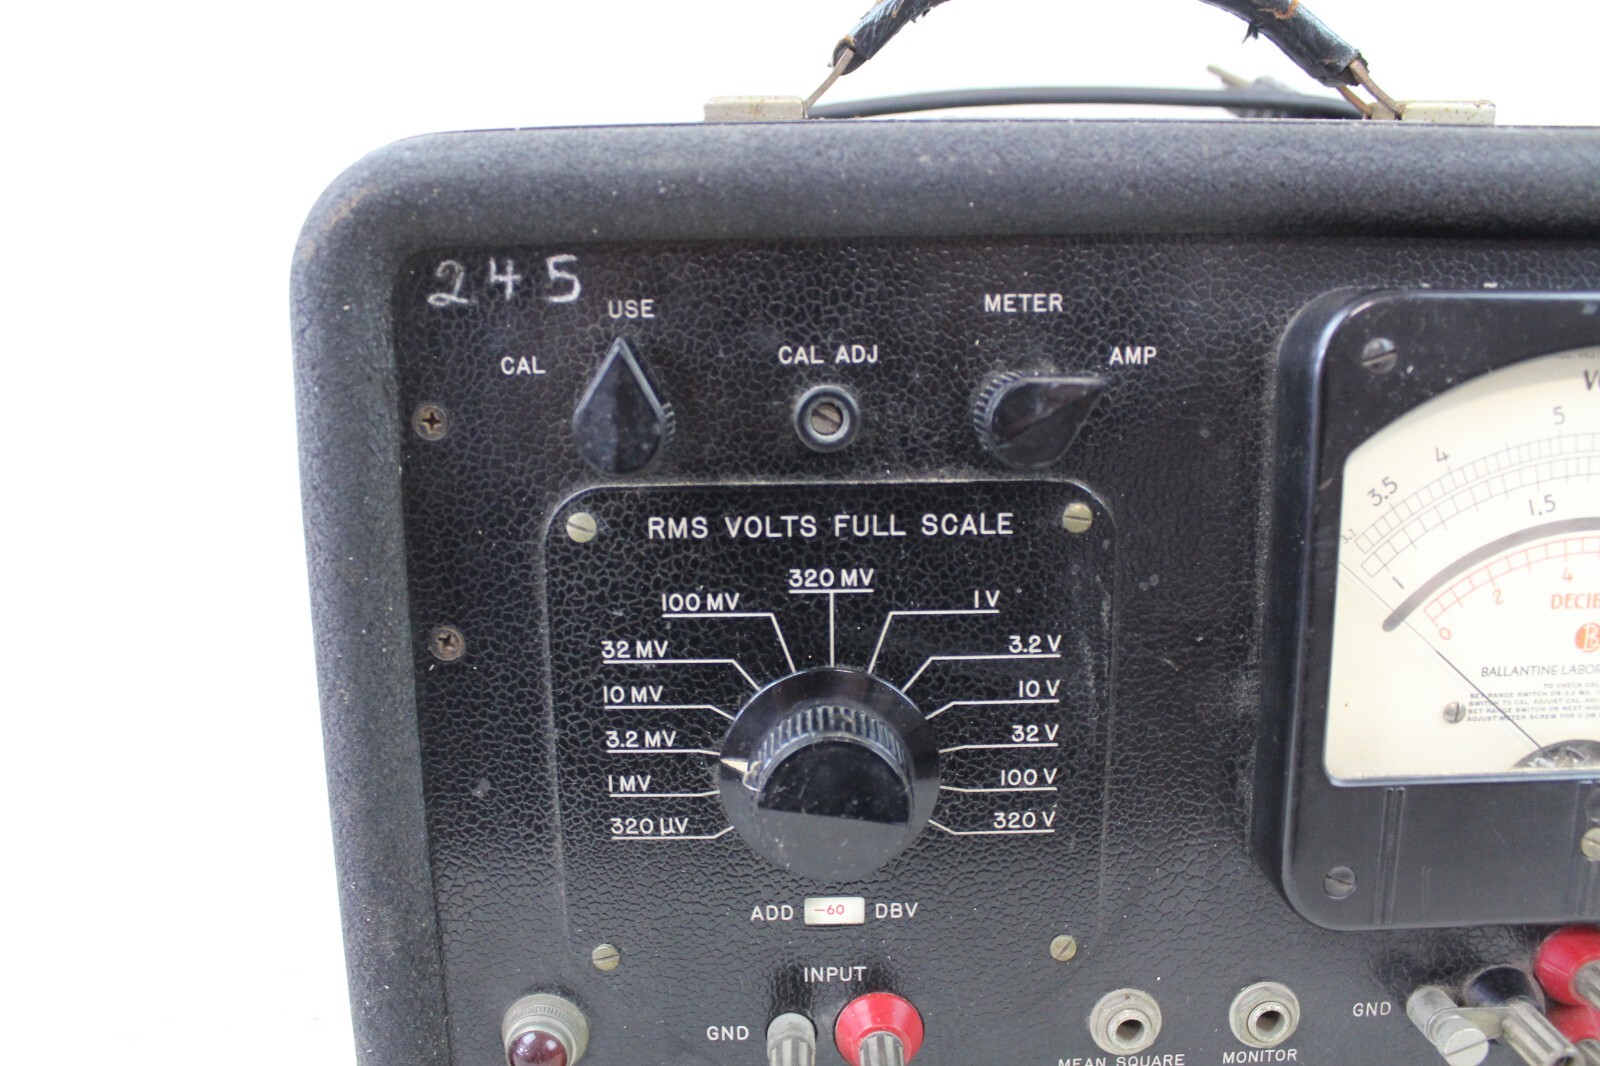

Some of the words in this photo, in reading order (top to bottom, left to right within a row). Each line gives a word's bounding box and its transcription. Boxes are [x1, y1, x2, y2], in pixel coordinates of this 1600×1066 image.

[607, 299, 655, 320] USE
[983, 293, 1064, 313] METER
[776, 345, 825, 365] CAL
[835, 344, 879, 364] ADJ
[1108, 345, 1158, 366] AMP
[500, 356, 546, 376] CAL
[1582, 368, 1600, 392] V
[1553, 405, 1566, 426] 5
[1434, 446, 1450, 464] 4
[1367, 475, 1399, 508] 3.5
[1528, 494, 1557, 517] 1.5
[647, 516, 709, 540] RMS
[724, 515, 818, 539] VOLTS
[834, 513, 907, 537] FULL
[921, 512, 1014, 536] SCALE
[788, 568, 835, 588] 320
[840, 567, 875, 587] MV
[1562, 567, 1574, 583] 4
[661, 593, 701, 612] 100
[706, 592, 740, 612] MV
[973, 589, 980, 609] 1
[985, 589, 1001, 608] V
[1492, 588, 1505, 606] 2
[601, 640, 631, 659] 32
[635, 639, 669, 659] MV
[1008, 634, 1042, 654] 3.2
[1047, 634, 1062, 652] V
[1480, 665, 1559, 678] BALLANTINE
[602, 686, 625, 704] 10
[630, 685, 664, 703] MV
[1018, 679, 1040, 698] 10
[1046, 679, 1061, 697] V
[605, 730, 639, 748] 3.2
[644, 730, 677, 748] MV
[1011, 724, 1039, 742] 32
[1045, 723, 1060, 741] V
[607, 775, 613, 793] 1
[619, 774, 651, 792] MV
[1000, 769, 1038, 786] 100
[1043, 768, 1058, 785] V
[610, 817, 654, 835] 320
[993, 812, 1036, 829] 320
[1042, 811, 1056, 828] V
[750, 905, 795, 921] ADD
[875, 902, 919, 919] DBV
[803, 966, 868, 983] INPUT
[1352, 1001, 1392, 1018] GND
[706, 1025, 750, 1041] GND
[1057, 1057, 1107, 1066] MEAN
[1115, 1053, 1186, 1066] SQUARE
[1222, 1048, 1298, 1065] MONITOR
